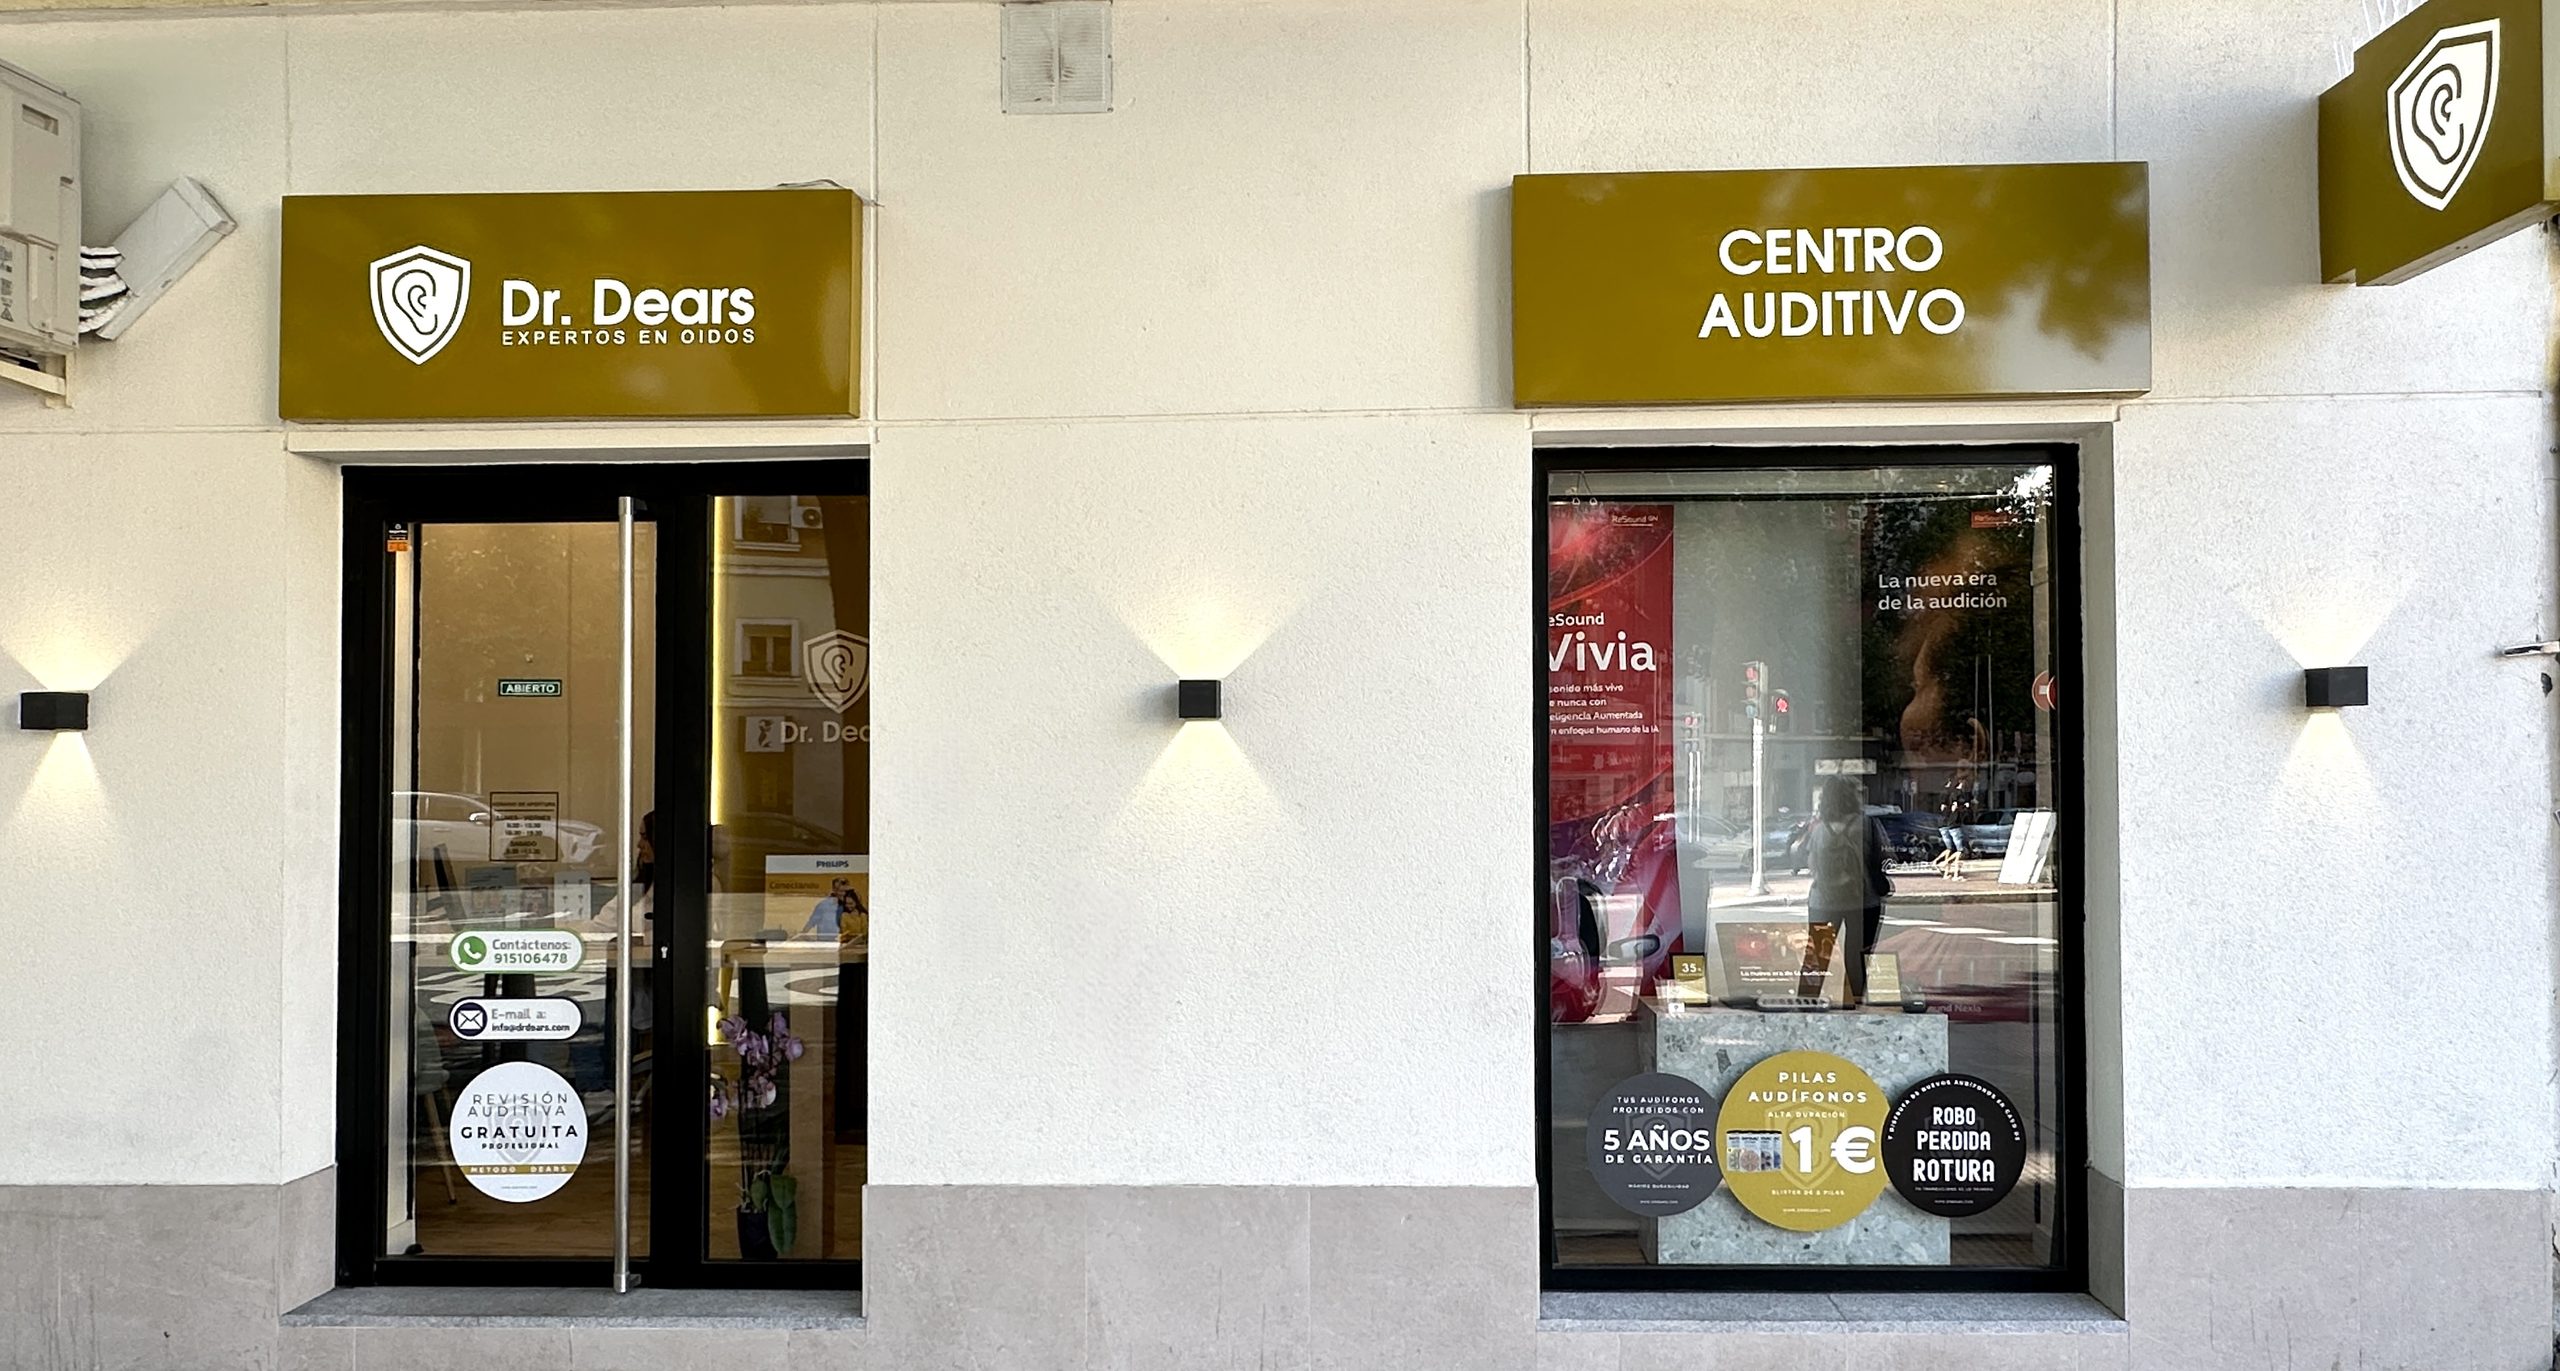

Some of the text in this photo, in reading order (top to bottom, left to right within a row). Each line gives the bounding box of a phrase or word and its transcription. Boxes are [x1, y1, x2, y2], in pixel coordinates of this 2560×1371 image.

[1718, 225, 1944, 276] CENTRO
[502, 278, 755, 326] Dr. Dears
[1697, 288, 1966, 338] AUDITIVO
[502, 328, 756, 346] EXPERTOS EN OIDOS
[1878, 574, 1998, 589] La nueva era
[1878, 592, 2008, 611] de la audición
[1549, 612, 1605, 627] eSound
[1549, 631, 1656, 672] Vivia
[506, 684, 556, 693] ABIERTO
[1583, 683, 1603, 692] más
[1605, 682, 1624, 692] vivo
[1557, 699, 1587, 707] nunca
[1589, 699, 1607, 707] con
[1549, 711, 1643, 722] eligencia Aumentada
[780, 721, 813, 743] Dr.
[816, 860, 849, 868] PHILIPS
[492, 939, 572, 950] Contáctenos:
[494, 953, 568, 964] 915106478
[491, 1008, 531, 1019] E-mail
[1778, 1071, 1836, 1084] PILAS
[473, 1091, 568, 1105] REVISIÓN
[1617, 1095, 1700, 1104] TUS AUDÍFONOS
[1748, 1088, 1868, 1103] AUDÍFONOS
[467, 1105, 566, 1117] AUDITIVA
[1612, 1106, 1704, 1114] PROTEGIDOS CON
[1933, 1106, 1976, 1126] ROBO
[461, 1125, 578, 1139] GRATUITA
[1603, 1129, 1620, 1151] 5
[1627, 1124, 1711, 1151] AÑOS
[1917, 1130, 1991, 1151] PERDIDA
[1789, 1125, 1876, 1174] 1 €
[1605, 1153, 1713, 1164] DE GARANTÍA
[530, 1165, 567, 1173] DEARS
[1913, 1158, 1995, 1182] ROTURA
